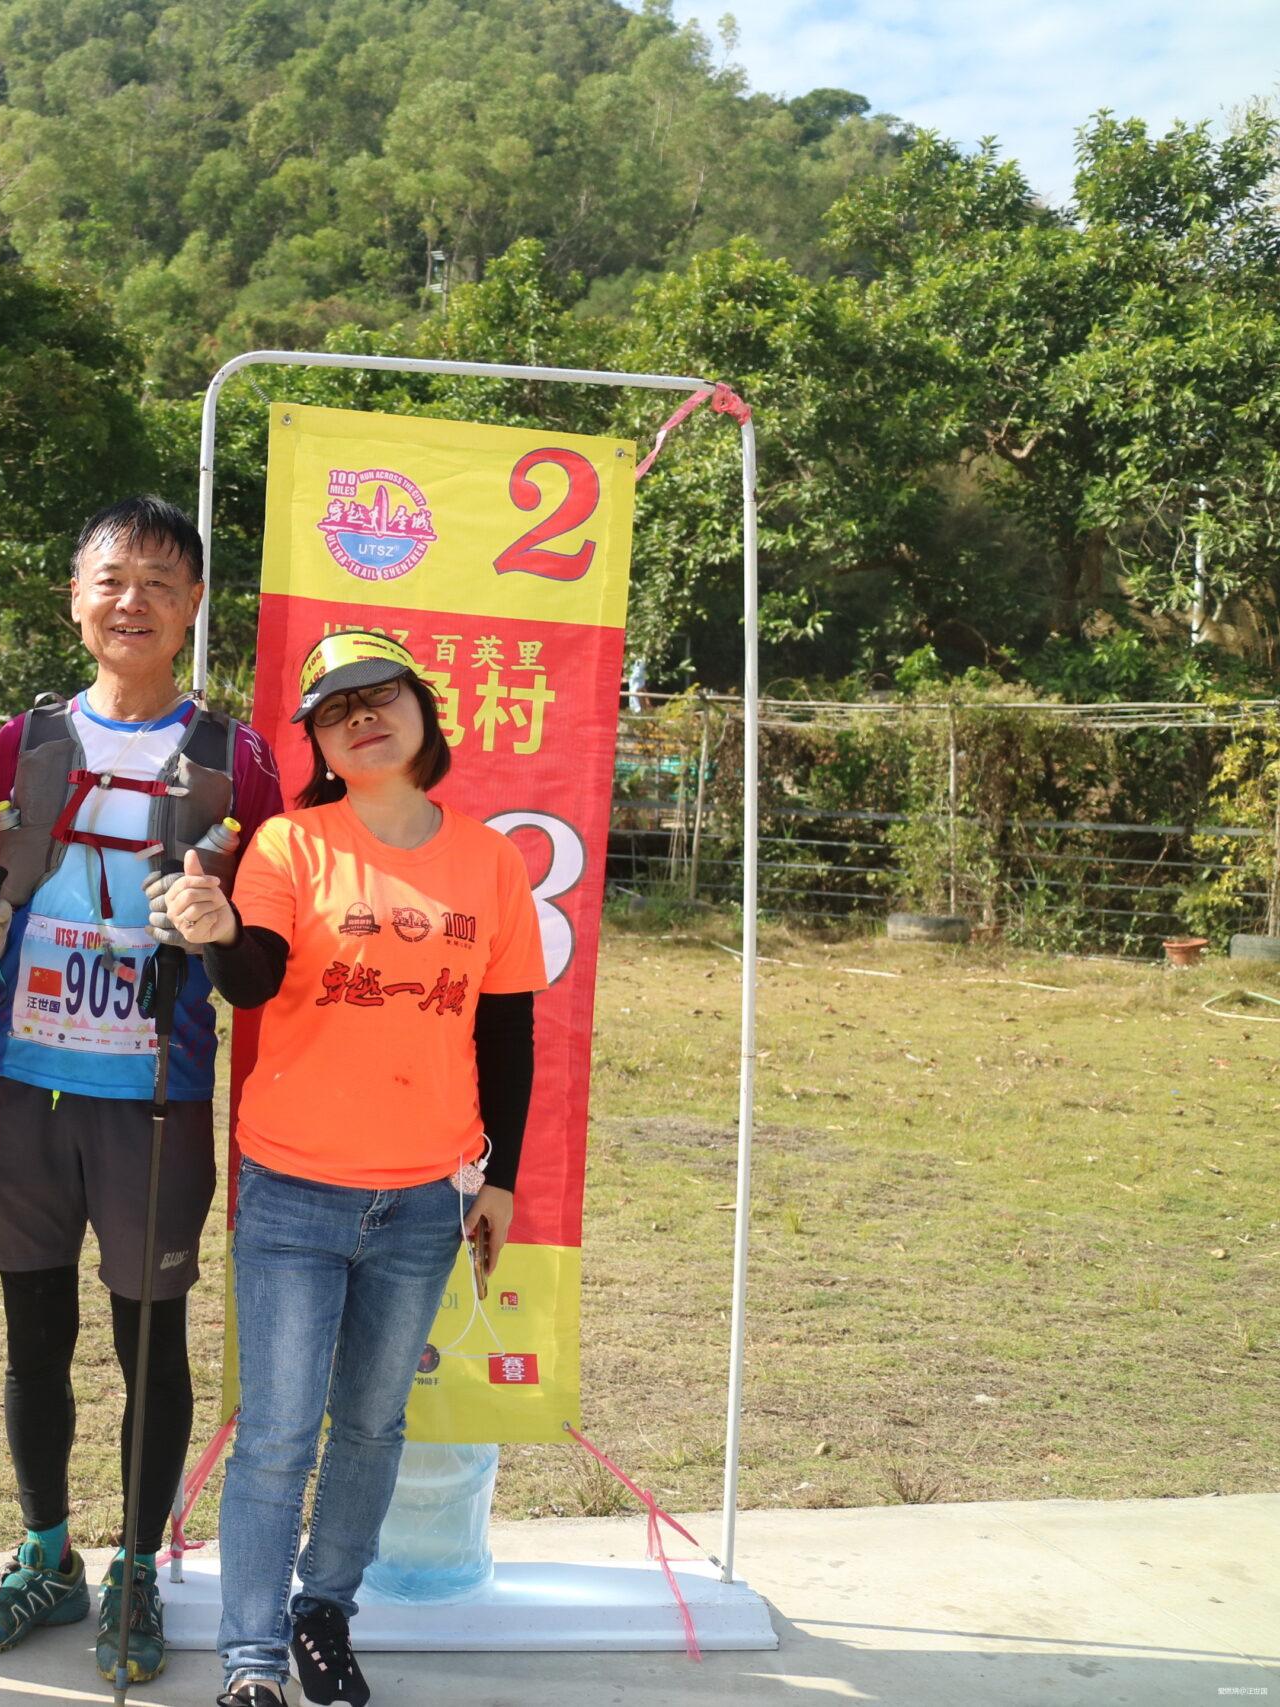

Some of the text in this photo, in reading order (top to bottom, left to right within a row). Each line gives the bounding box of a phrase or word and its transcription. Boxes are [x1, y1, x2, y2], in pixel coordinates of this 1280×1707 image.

[329, 484, 356, 496] MILES
[331, 471, 356, 485] 100
[359, 470, 426, 506] RUN ACROSS THE CITY
[493, 447, 601, 581] 2
[326, 533, 427, 580] ULTRA-TRAIL SHENZHEN
[431, 634, 546, 671] 百英里
[55, 927, 79, 949] UTSZ
[81, 931, 102, 949] 100
[26, 995, 61, 1013] 汪世国
